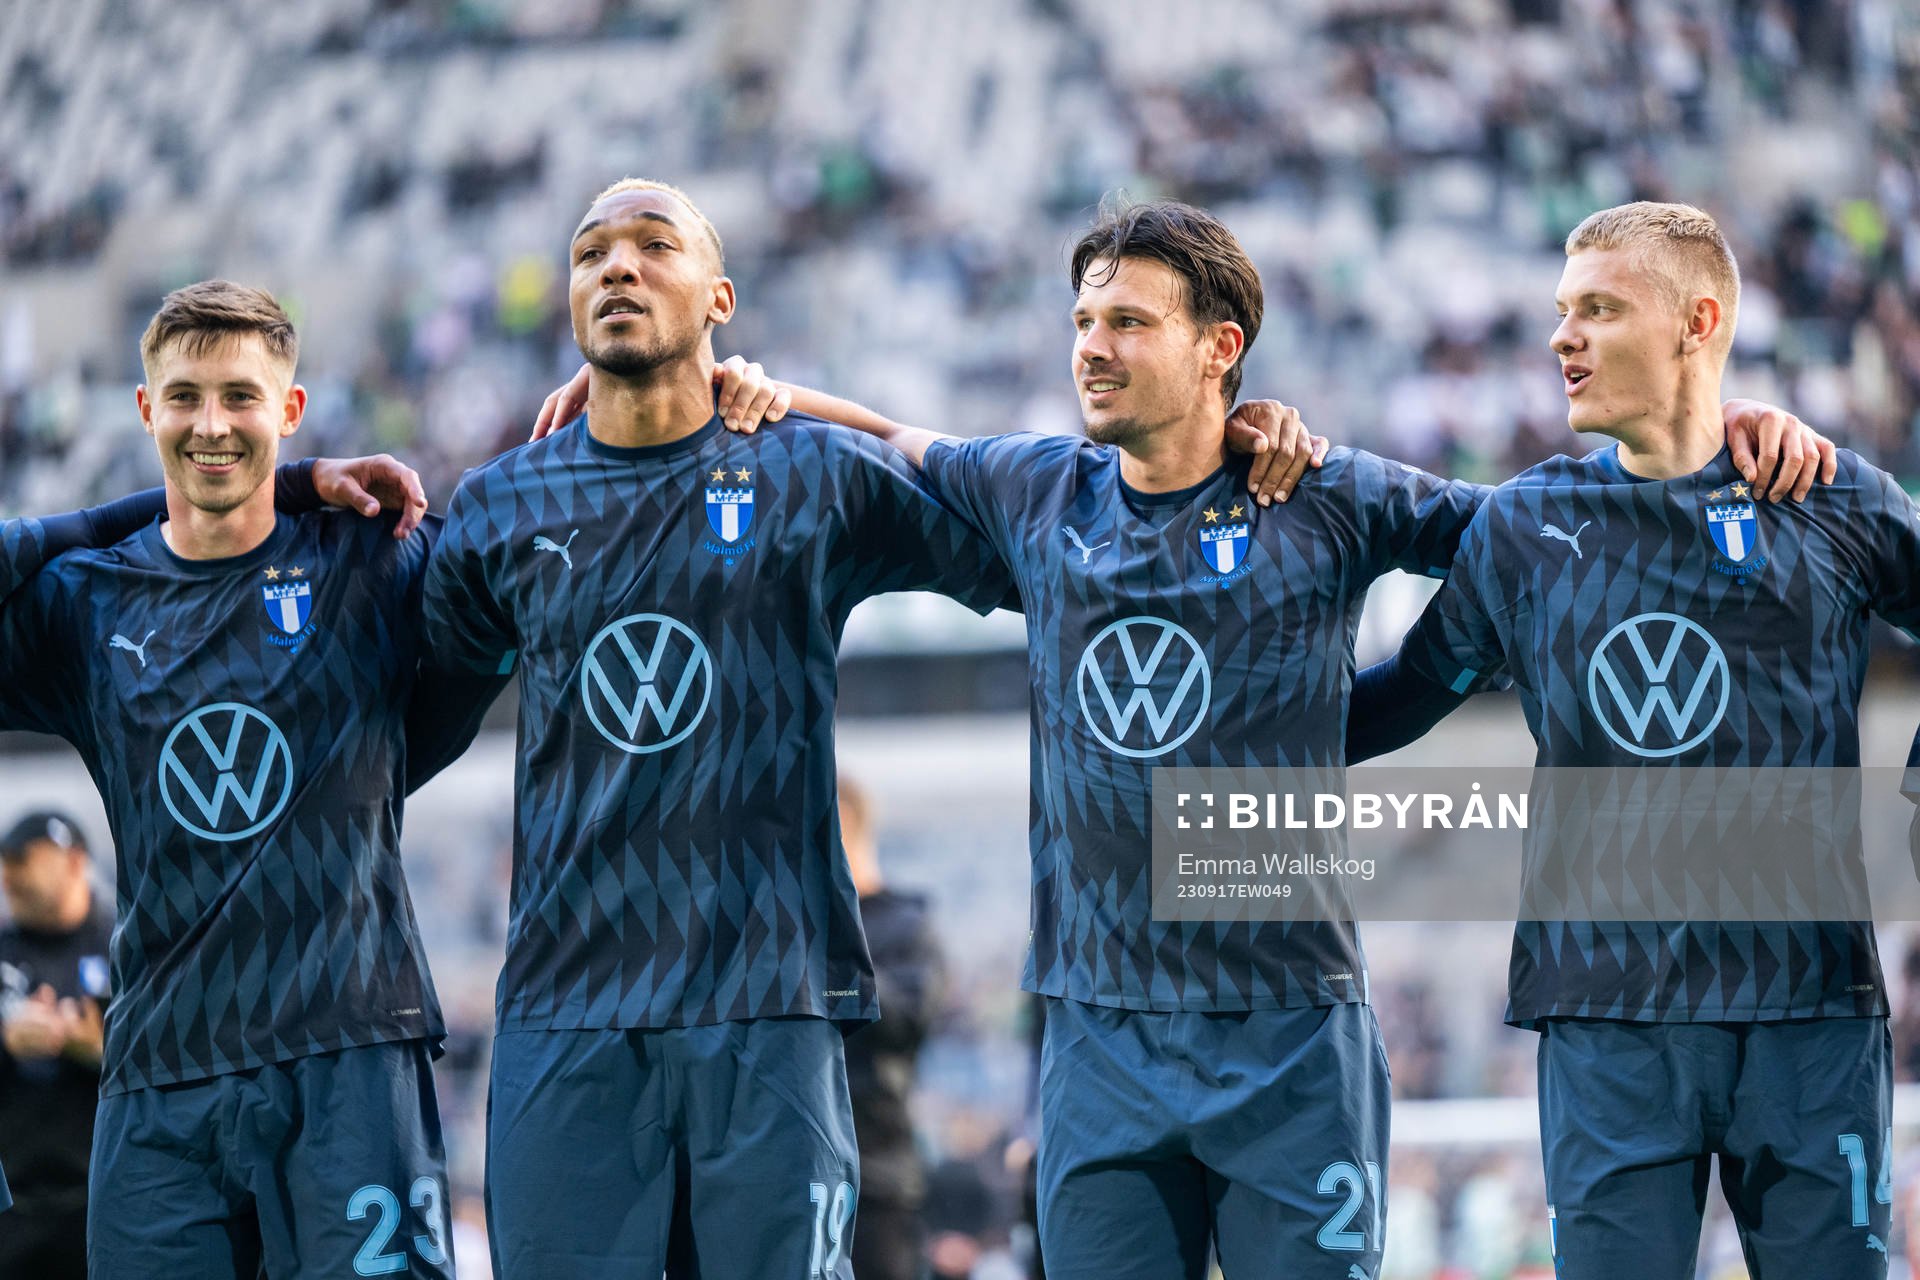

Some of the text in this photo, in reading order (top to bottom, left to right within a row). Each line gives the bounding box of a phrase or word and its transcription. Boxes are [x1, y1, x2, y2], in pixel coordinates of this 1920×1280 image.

[581, 613, 712, 753] VW
[1077, 616, 1211, 757] VW
[1588, 612, 1730, 757] VW
[158, 702, 293, 841] VW
[822, 989, 860, 997] ULTRAWEAVE
[346, 1176, 447, 1277] 23
[809, 1181, 856, 1275] 19
[1316, 1161, 1382, 1251] 21
